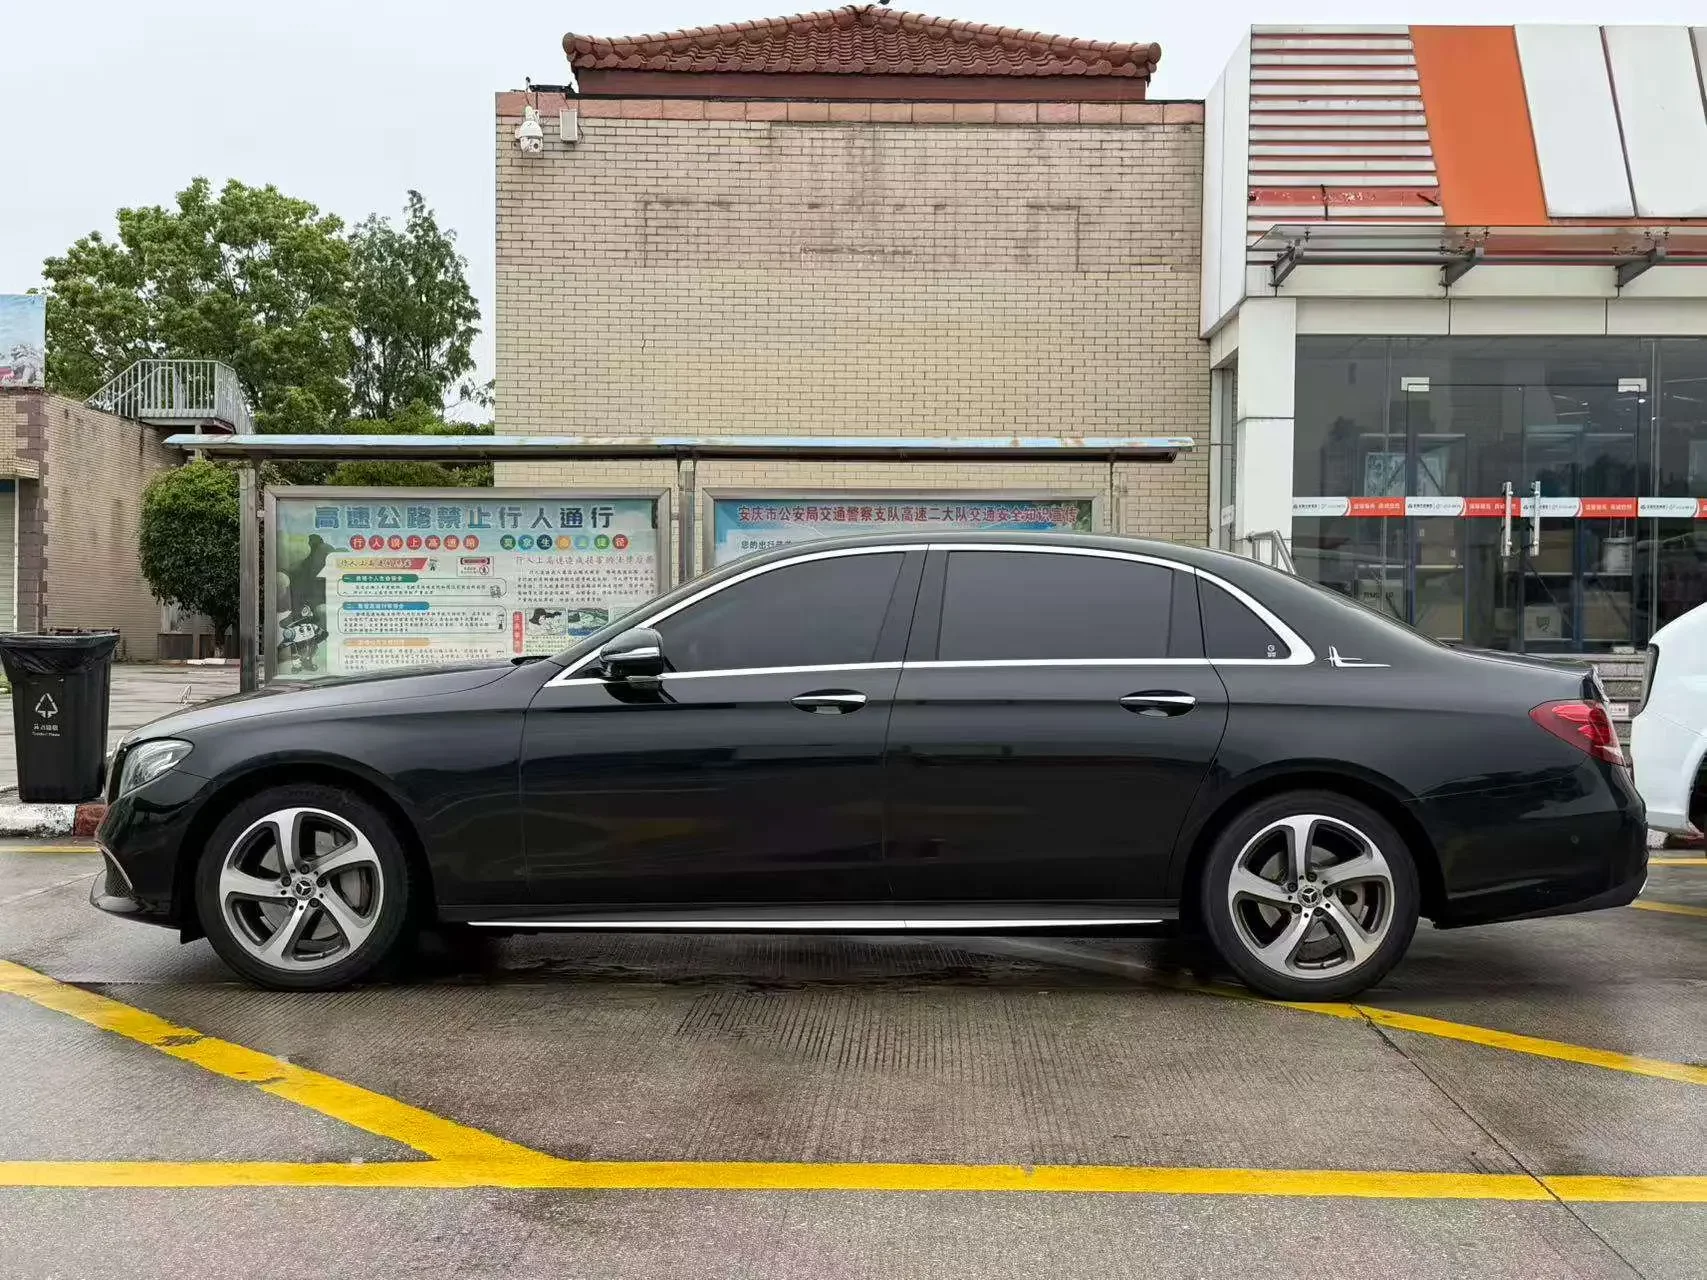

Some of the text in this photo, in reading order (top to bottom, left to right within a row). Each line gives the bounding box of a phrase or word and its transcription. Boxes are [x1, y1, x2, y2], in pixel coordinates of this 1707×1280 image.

[314, 505, 615, 530] 高速公路禁止行人通行
